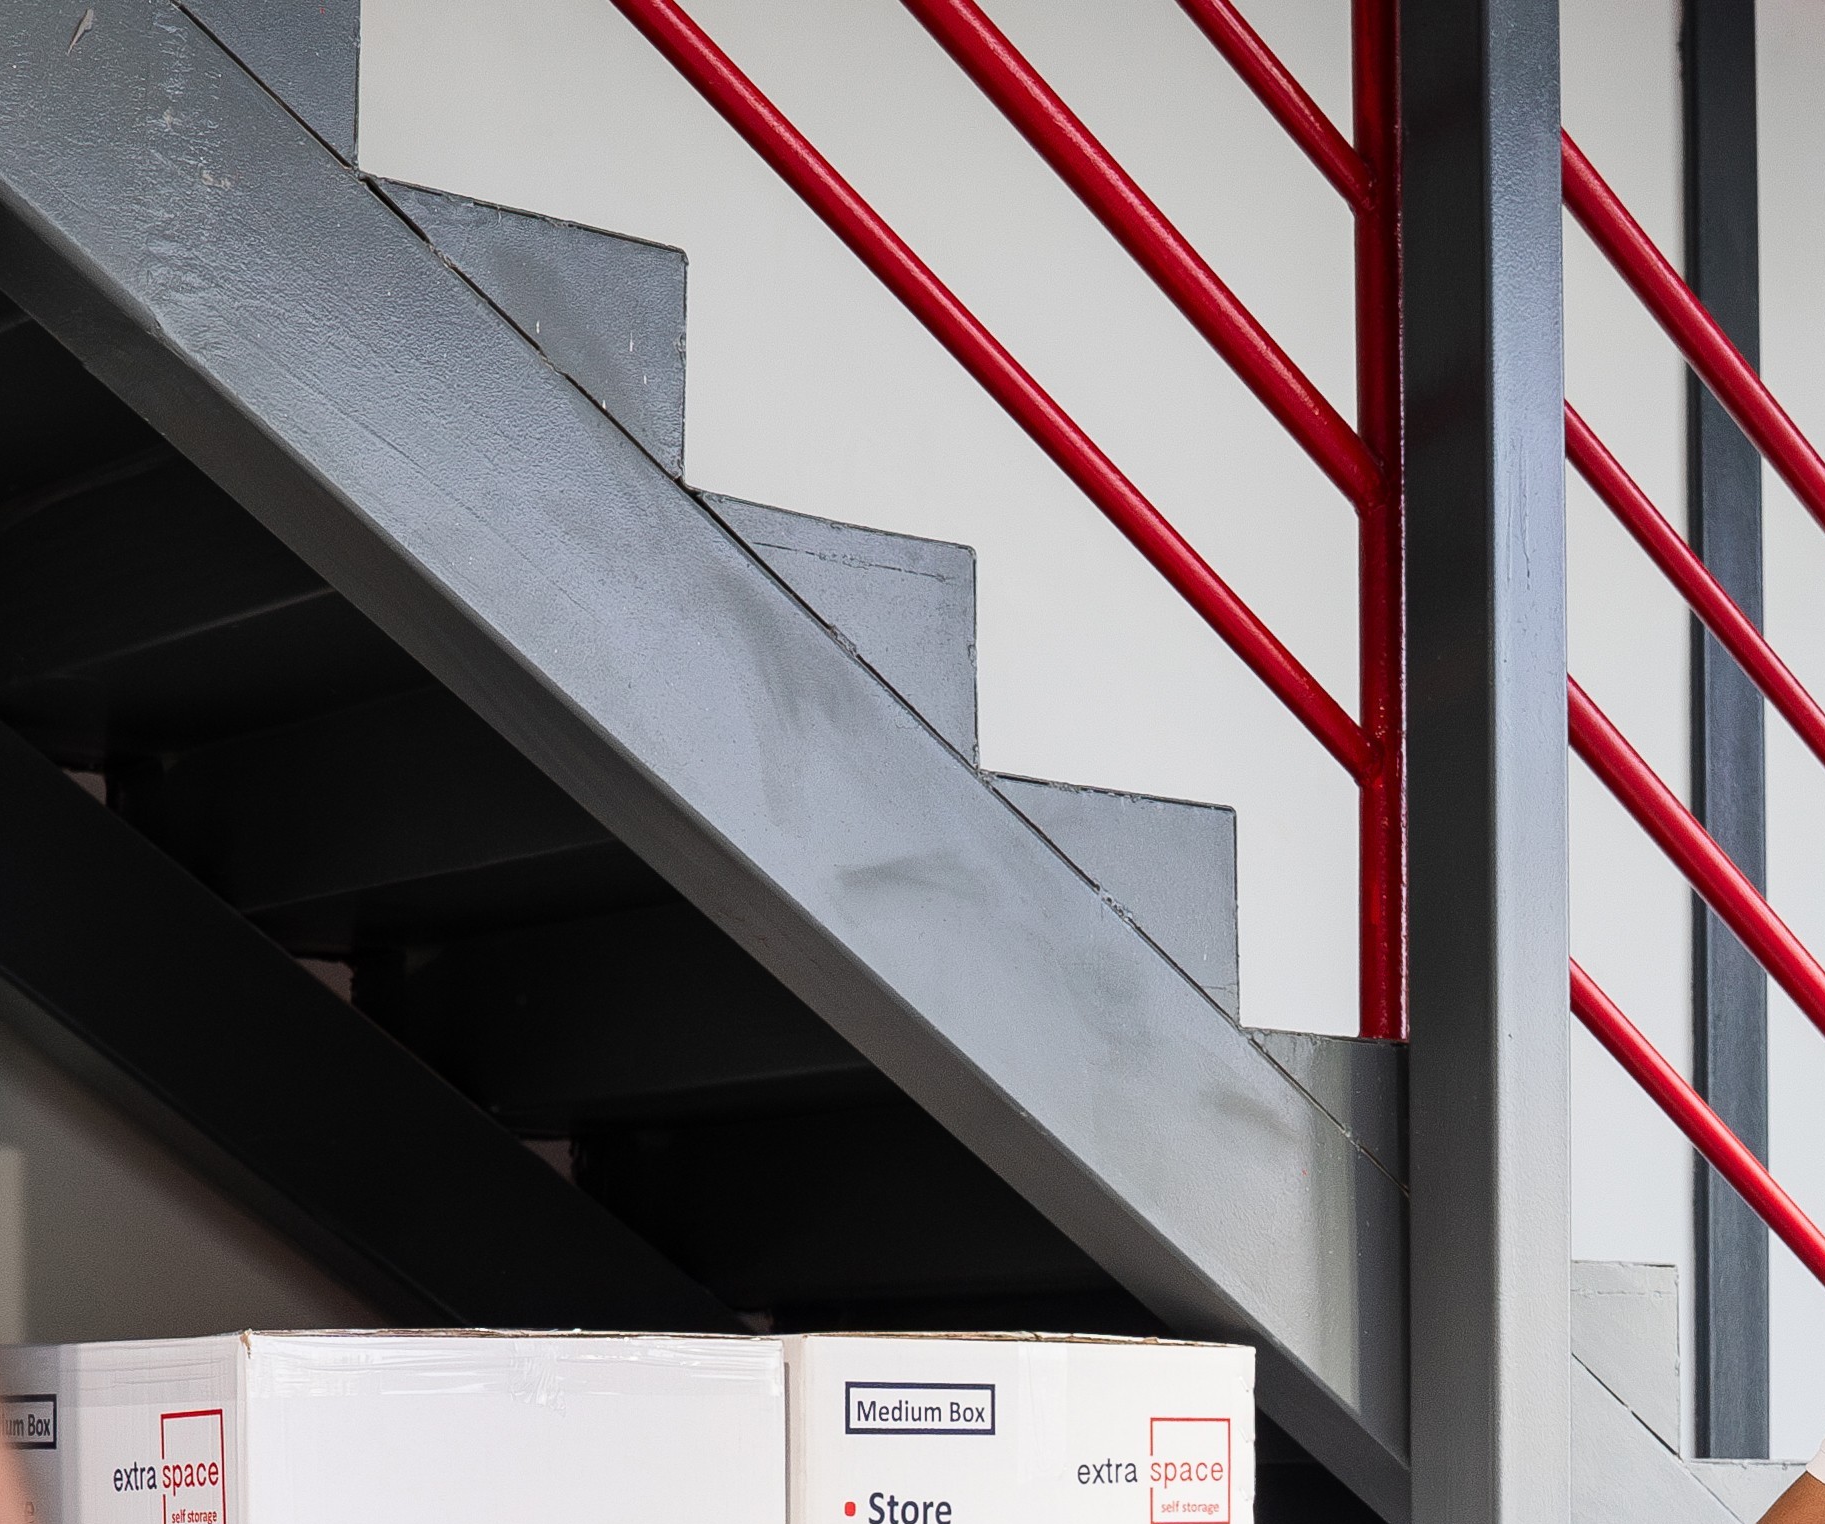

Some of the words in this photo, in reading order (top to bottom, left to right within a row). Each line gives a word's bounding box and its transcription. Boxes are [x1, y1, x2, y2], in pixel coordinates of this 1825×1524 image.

[857, 1400, 942, 1423] Medium
[949, 1402, 986, 1423] Box
[27, 1413, 51, 1437] Box
[113, 1461, 157, 1492] extra
[162, 1462, 219, 1497] space
[1077, 1458, 1138, 1485] extra
[1150, 1461, 1224, 1489] space
[171, 1509, 186, 1523] self
[187, 1510, 217, 1524] storage
[1161, 1500, 1180, 1513] self
[1182, 1501, 1220, 1515] storage
